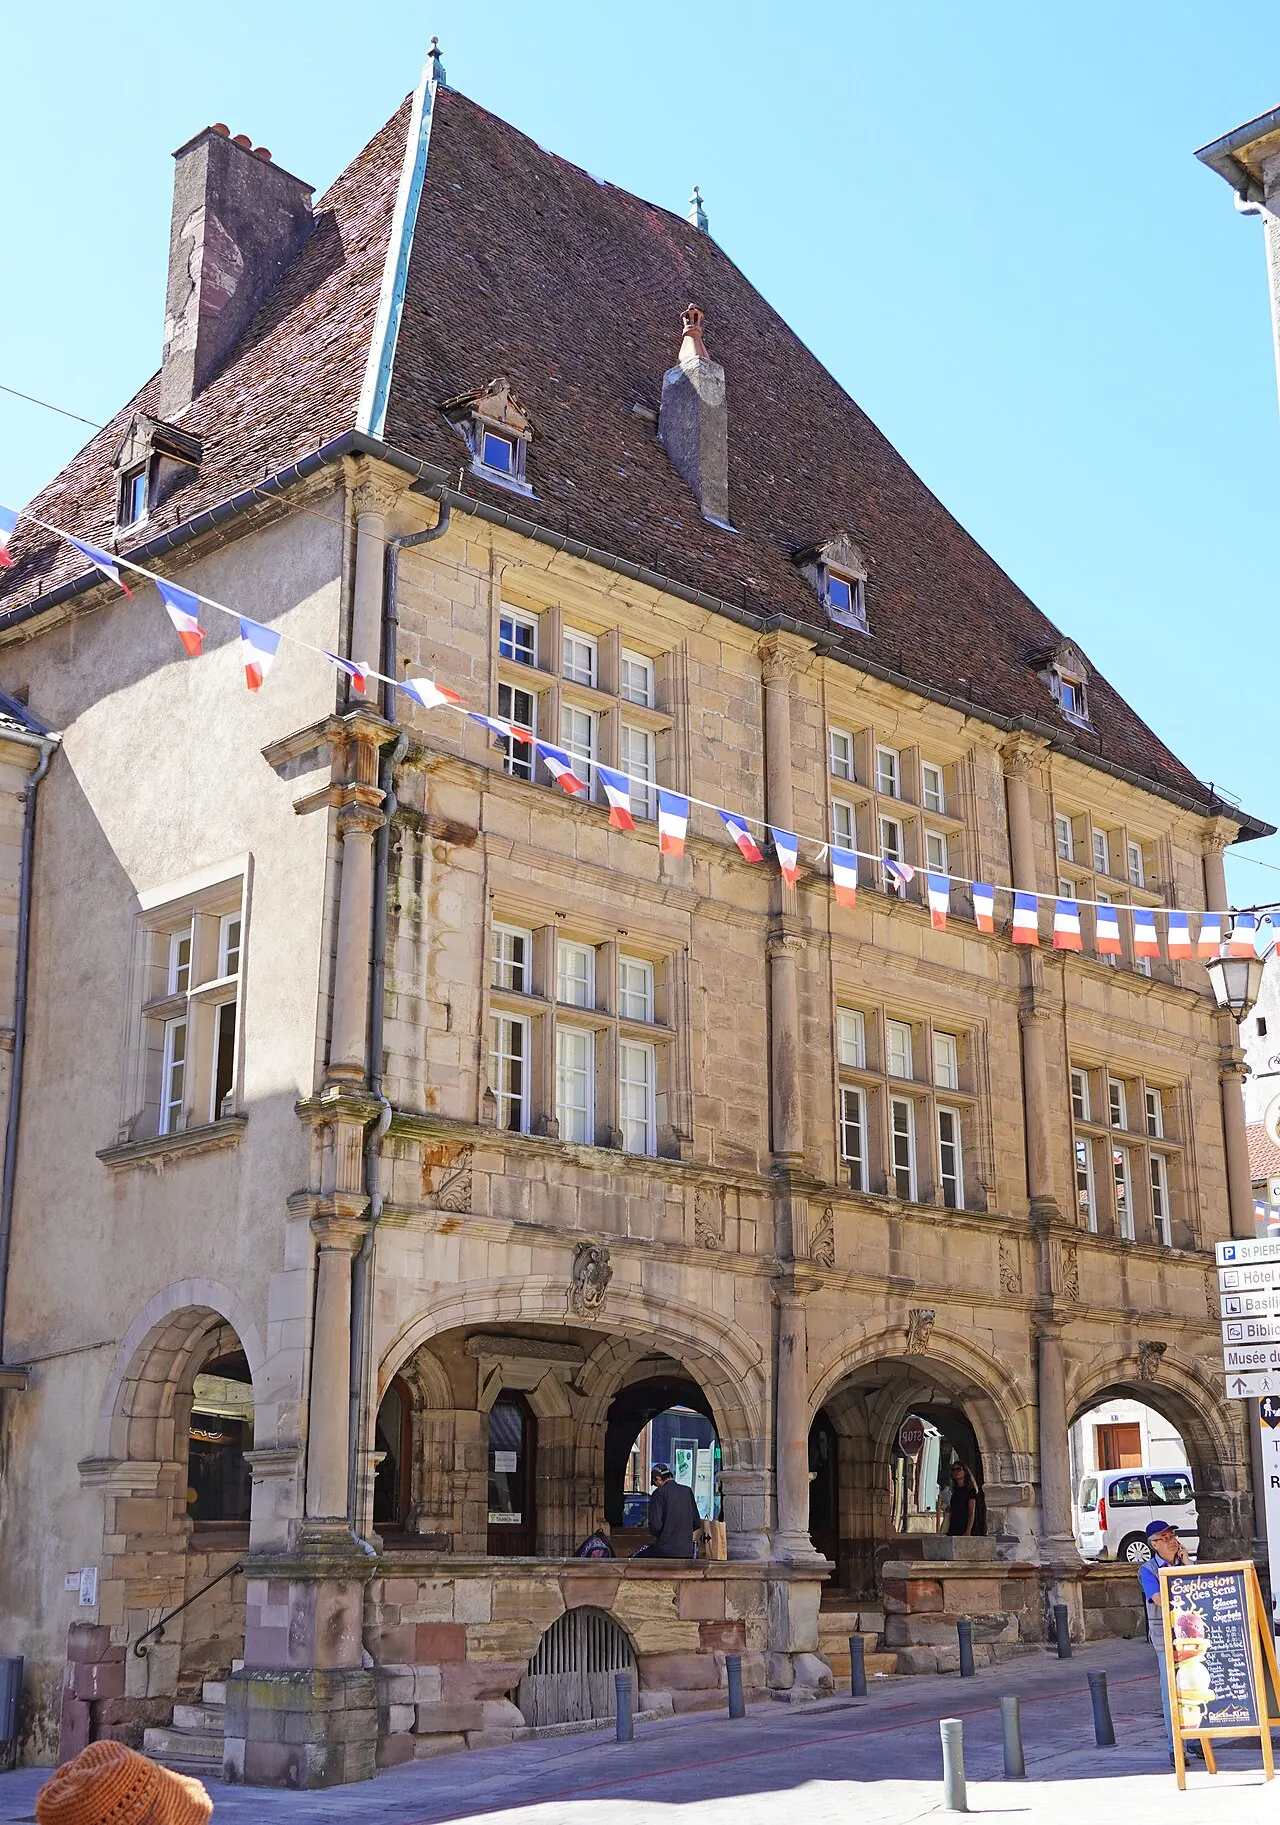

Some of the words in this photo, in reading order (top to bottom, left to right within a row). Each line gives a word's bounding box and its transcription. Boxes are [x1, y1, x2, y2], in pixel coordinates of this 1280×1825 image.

[1225, 1247, 1234, 1260] P
[1241, 1247, 1251, 1258] St
[1243, 1269, 1275, 1284] Hôtel
[1228, 1350, 1266, 1365] Musée
[1171, 1574, 1235, 1595] Explosion
[1192, 1590, 1210, 1600] des
